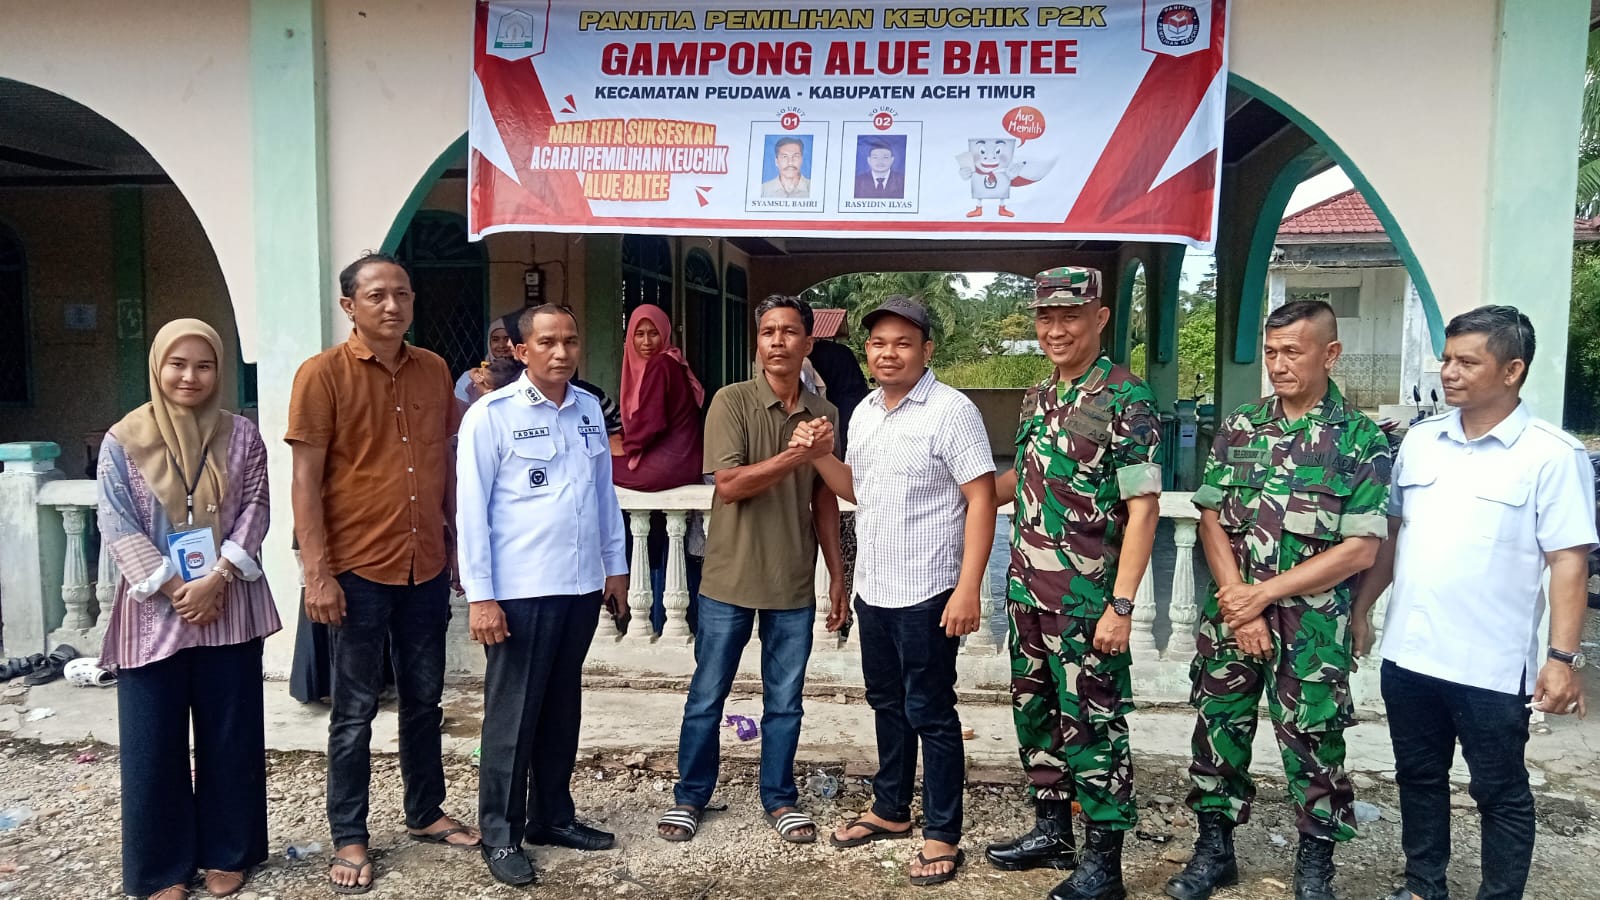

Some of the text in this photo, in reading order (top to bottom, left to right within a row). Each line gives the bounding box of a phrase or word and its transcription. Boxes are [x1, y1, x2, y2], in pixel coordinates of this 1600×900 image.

[579, 6, 1107, 31] PANITIA PEMILIHAN KEUCHIK P2K
[601, 40, 1077, 76] GAMPONG ALUE BATEE
[595, 86, 699, 99] KECAMATAN
[705, 86, 791, 99] PEUDAWA
[809, 86, 914, 99] KABUPATEN
[921, 86, 970, 99] ACEH
[977, 85, 1035, 99] TIMUR
[783, 117, 798, 126] 01
[875, 117, 891, 126] 02
[1015, 109, 1034, 124] Ayo
[548, 120, 714, 145] MARI KITA SUKSESKAN
[1008, 121, 1042, 134] Memilih
[530, 147, 728, 172] ACARA PEMILIHAN KEUCHIK
[584, 173, 669, 199] ALUE BATEE
[751, 200, 818, 208] SYAMSUL BAHRI
[845, 200, 886, 208] RASYIDIN
[518, 429, 545, 437] ADNAN
[1331, 456, 1350, 469] AD
